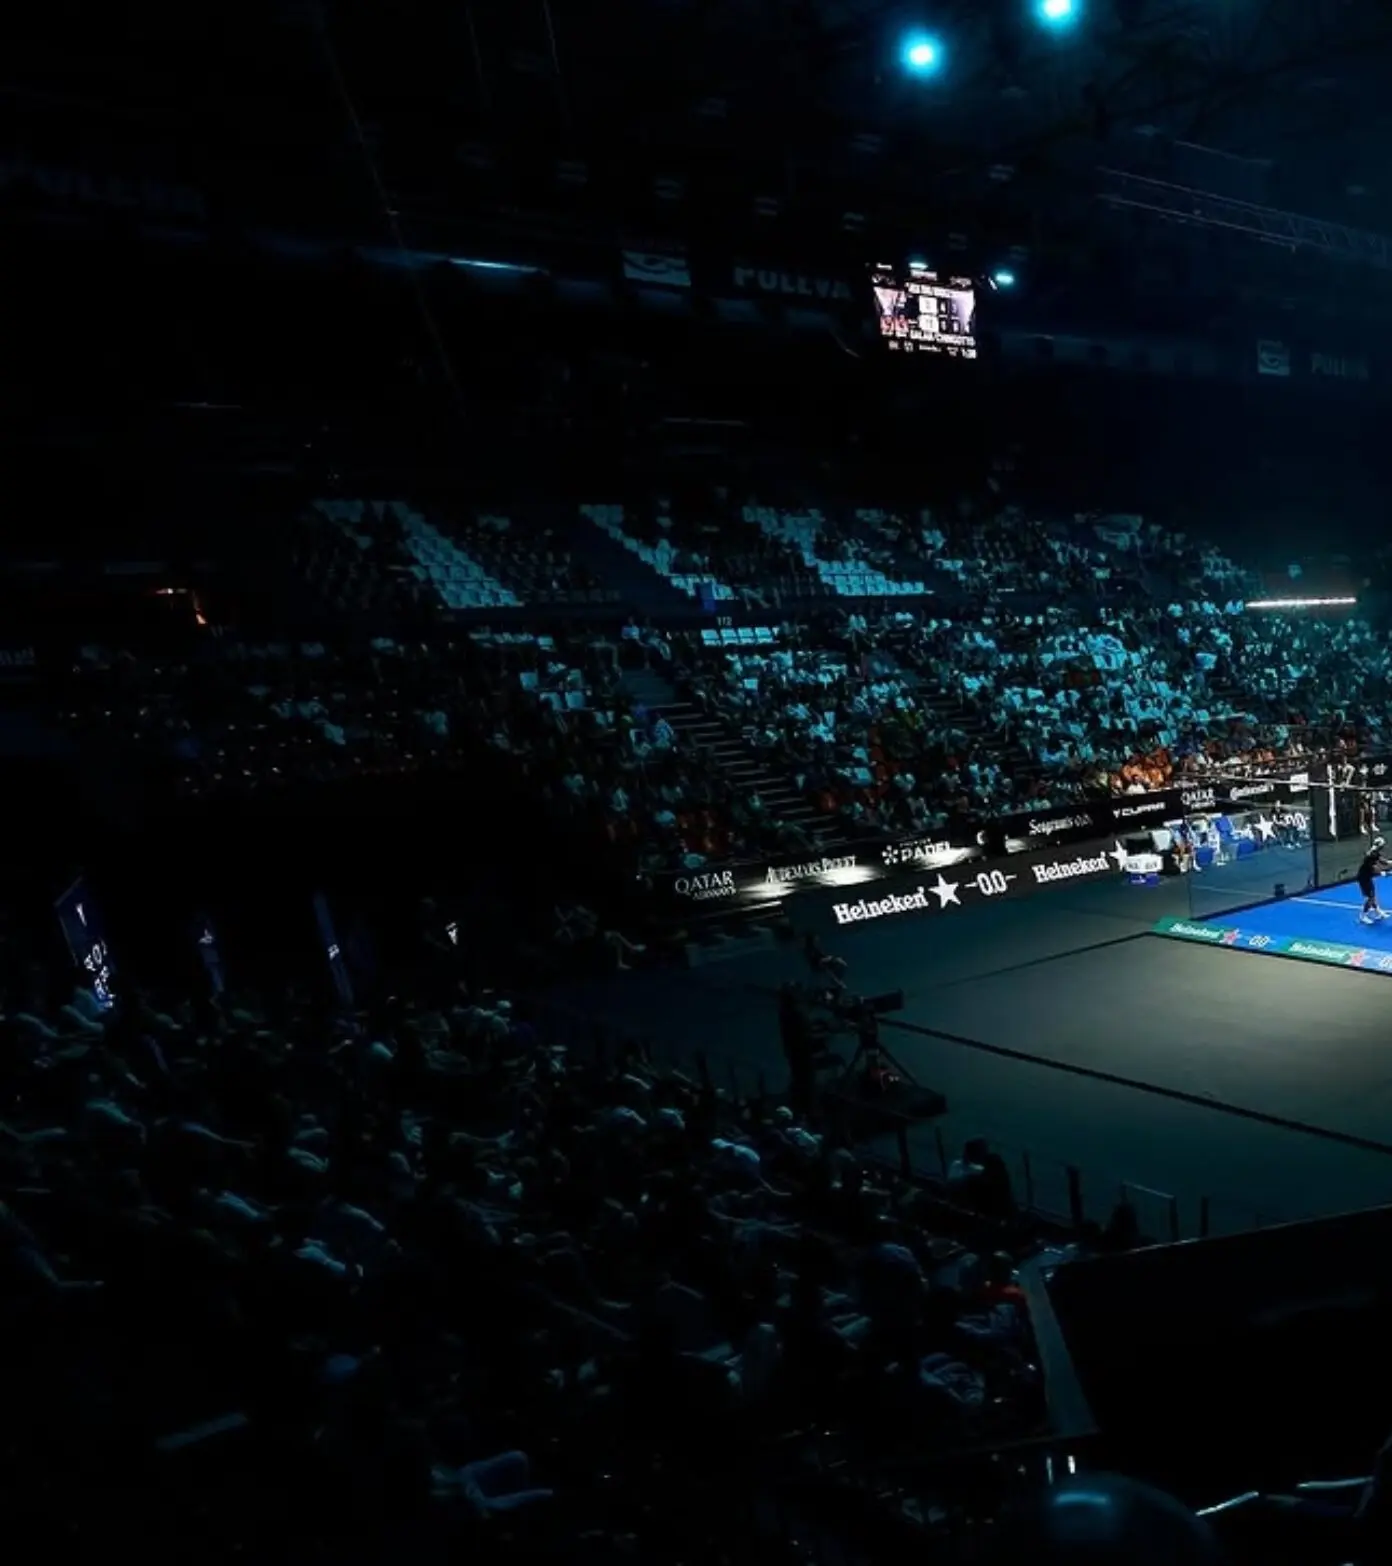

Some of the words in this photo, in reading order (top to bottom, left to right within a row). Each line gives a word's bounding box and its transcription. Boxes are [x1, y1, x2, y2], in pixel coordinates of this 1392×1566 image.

[675, 870, 735, 896] QATAR
[1032, 850, 1110, 884] Heineken
[832, 886, 930, 924] Heineken
